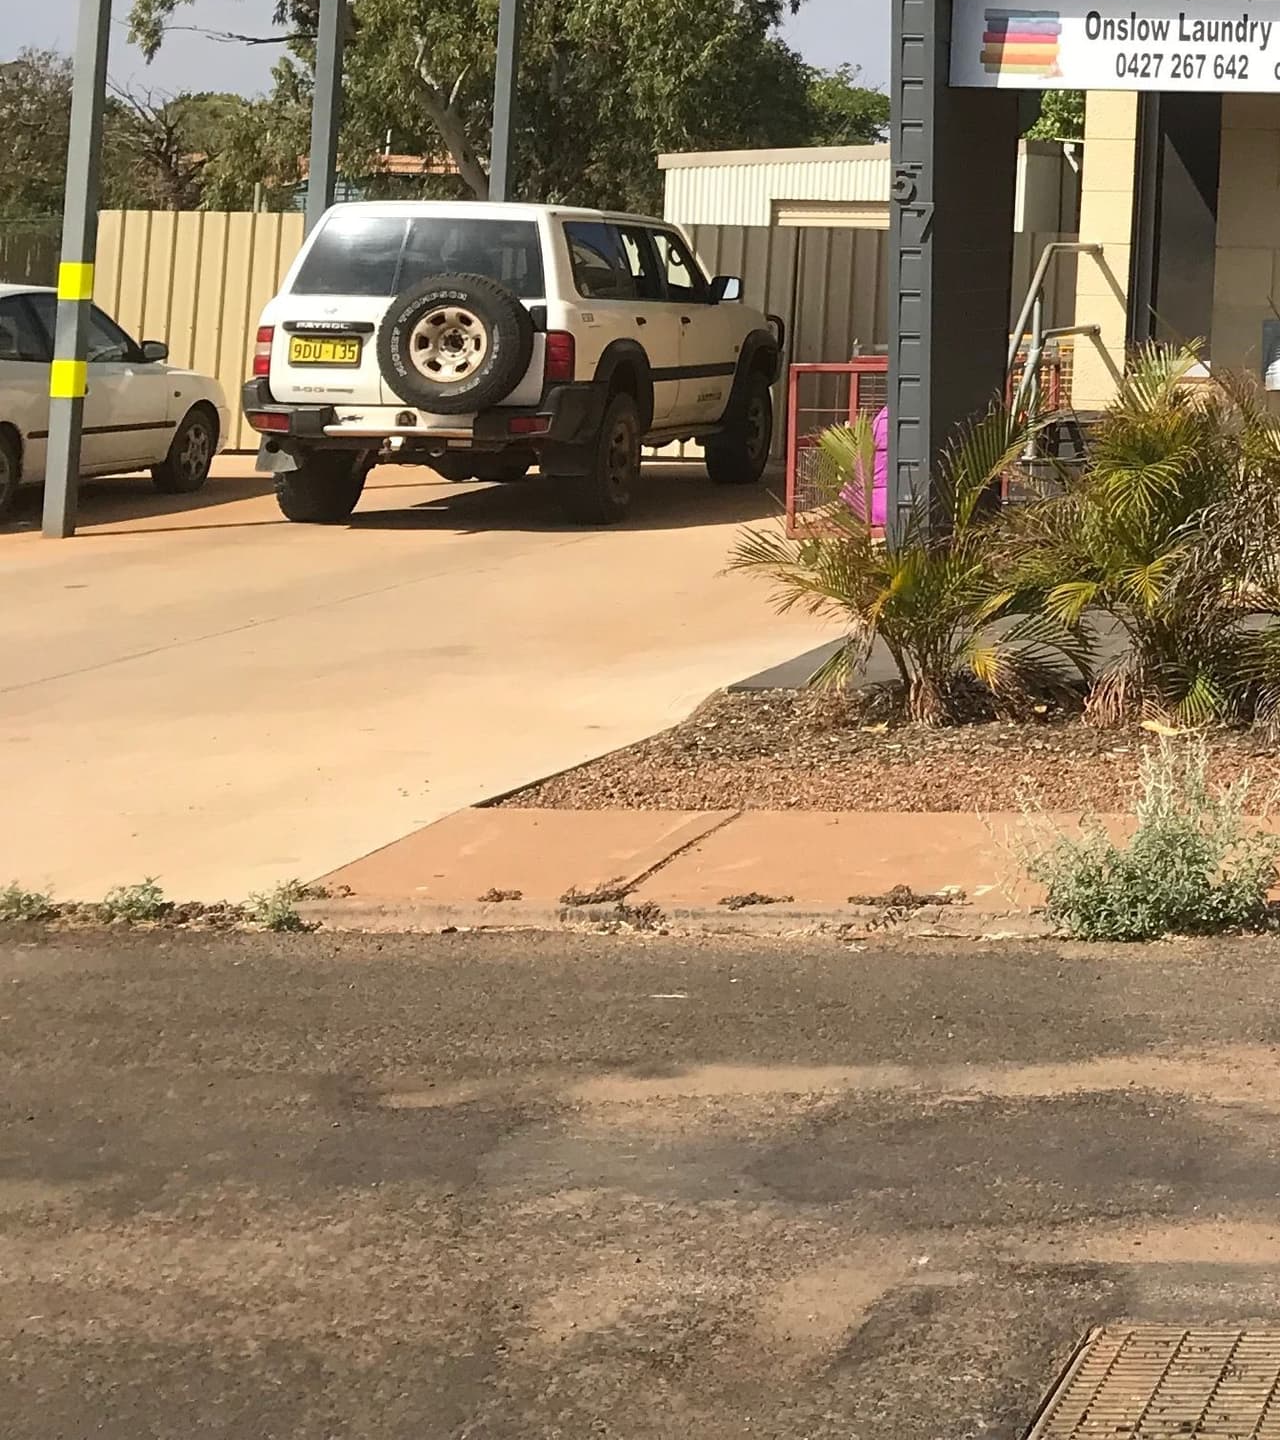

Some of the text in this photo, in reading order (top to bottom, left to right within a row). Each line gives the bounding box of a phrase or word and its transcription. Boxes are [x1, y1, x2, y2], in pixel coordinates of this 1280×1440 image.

[1085, 10, 1171, 42] Onslow
[1178, 12, 1273, 51] Laundry
[1115, 52, 1164, 79] 0427
[1170, 53, 1207, 79] 267
[1213, 54, 1249, 80] 642
[295, 321, 351, 330] PATROL
